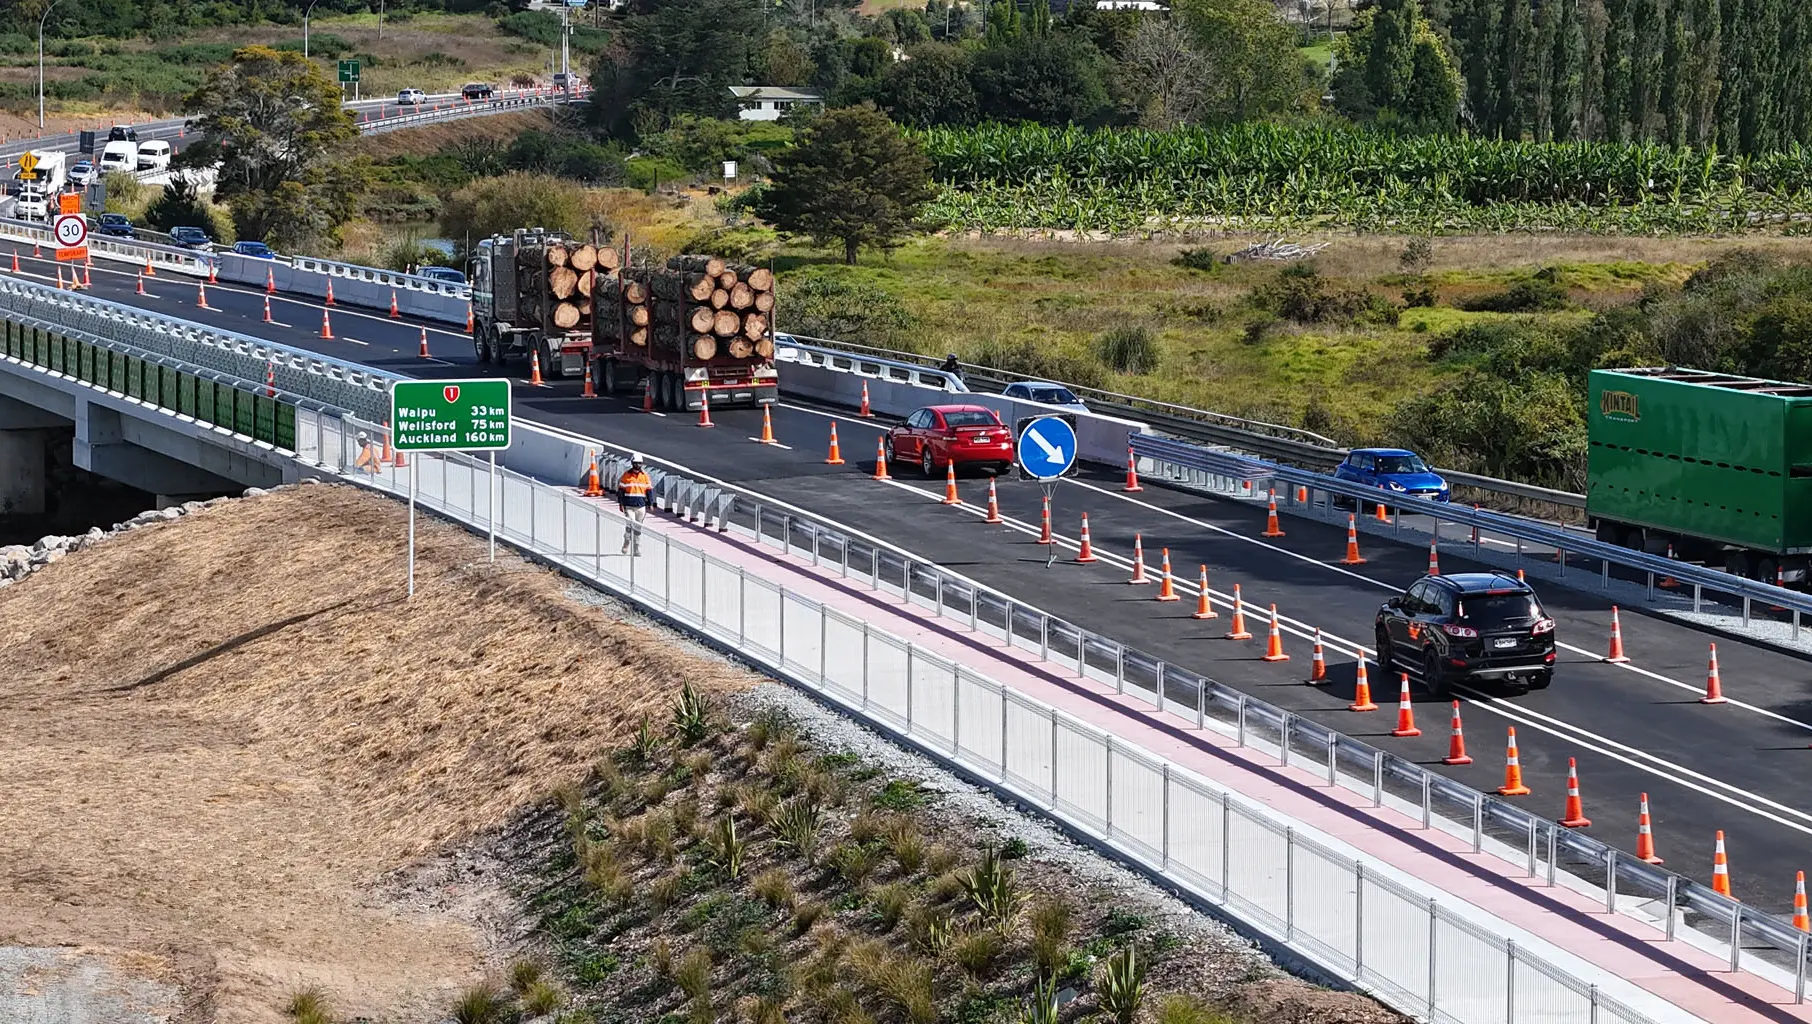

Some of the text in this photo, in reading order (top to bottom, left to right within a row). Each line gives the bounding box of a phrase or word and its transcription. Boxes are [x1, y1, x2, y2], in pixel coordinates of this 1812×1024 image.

[62, 224, 79, 236] 30
[1602, 391, 1640, 419] KINTAIL
[398, 406, 504, 419] Waipu 33 km
[398, 419, 504, 431] Wellsford 75 km
[398, 432, 504, 444] Auckland 160 km
